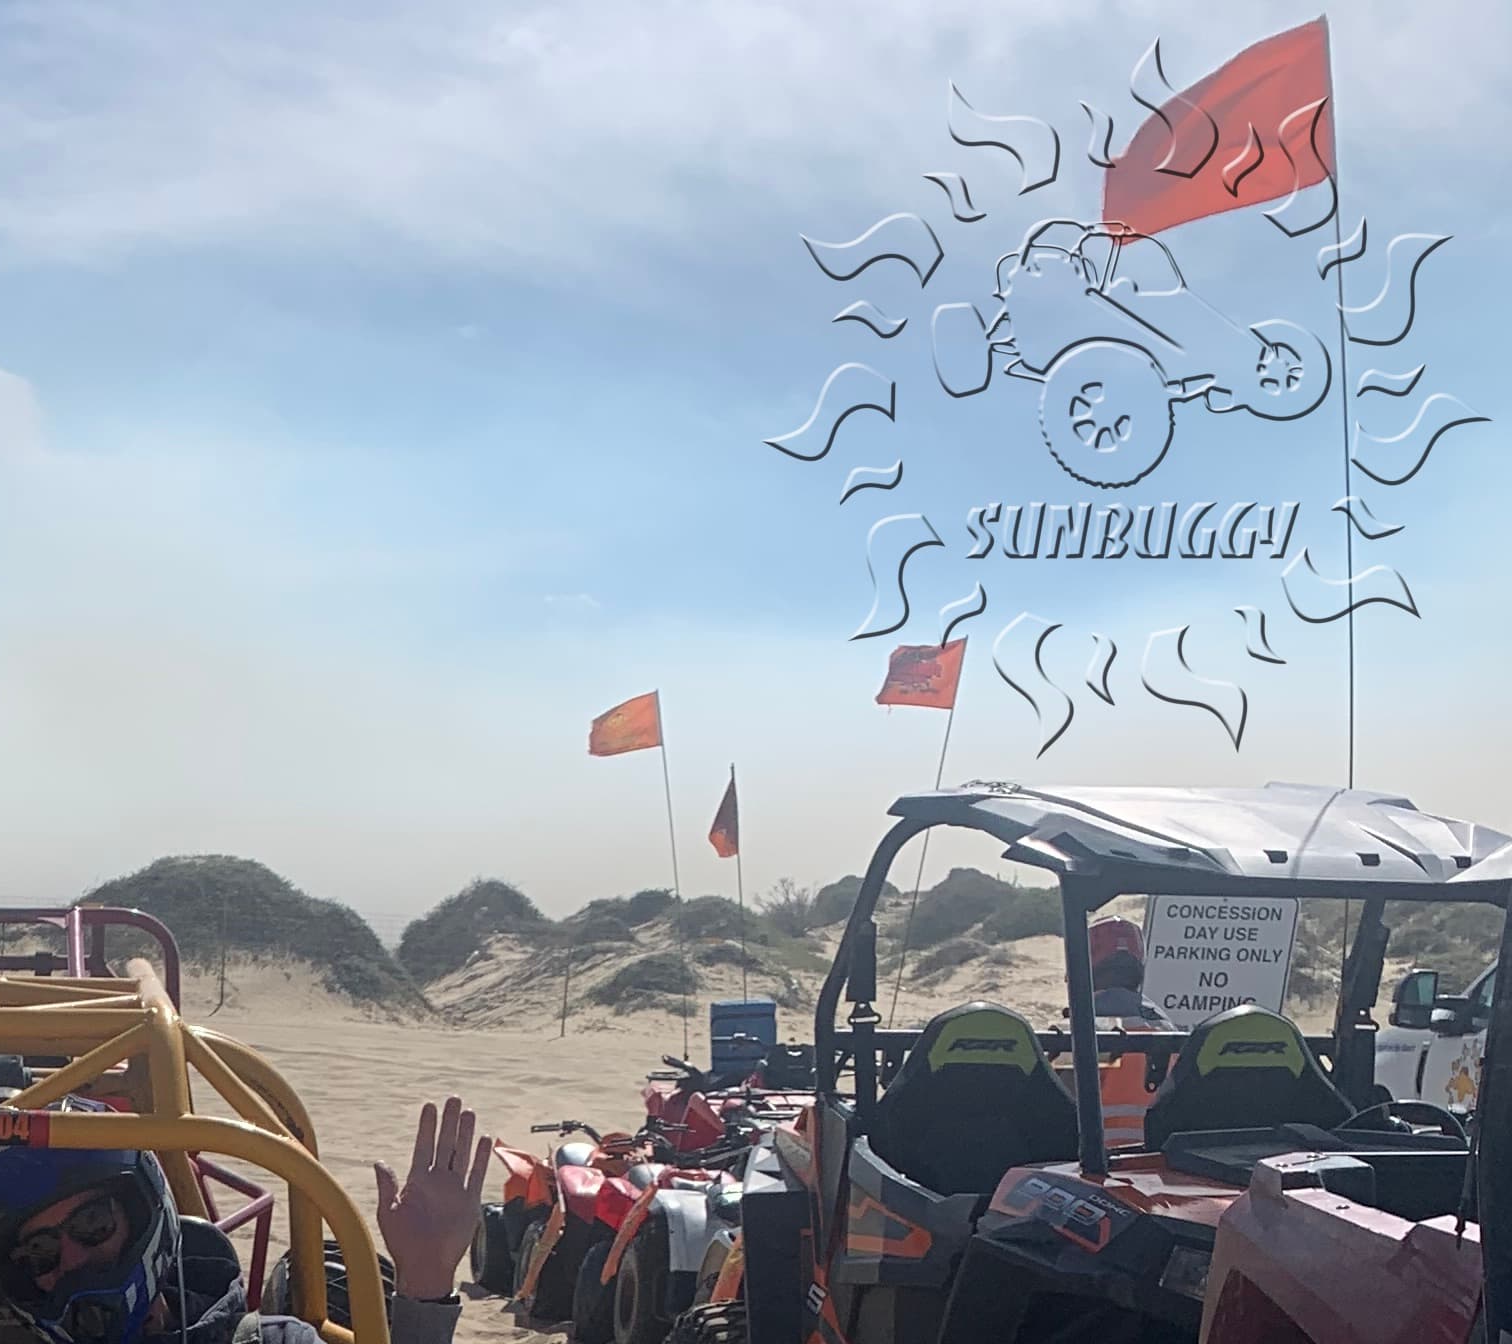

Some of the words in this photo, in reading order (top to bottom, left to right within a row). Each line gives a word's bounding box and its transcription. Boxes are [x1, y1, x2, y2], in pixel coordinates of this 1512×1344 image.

[1166, 904, 1283, 921] CONCESSION
[1183, 926, 1219, 940] DAY
[1223, 927, 1259, 941] USE
[1154, 945, 1231, 961] PARKING
[1236, 948, 1283, 963] ONLY
[1199, 972, 1229, 988] NO
